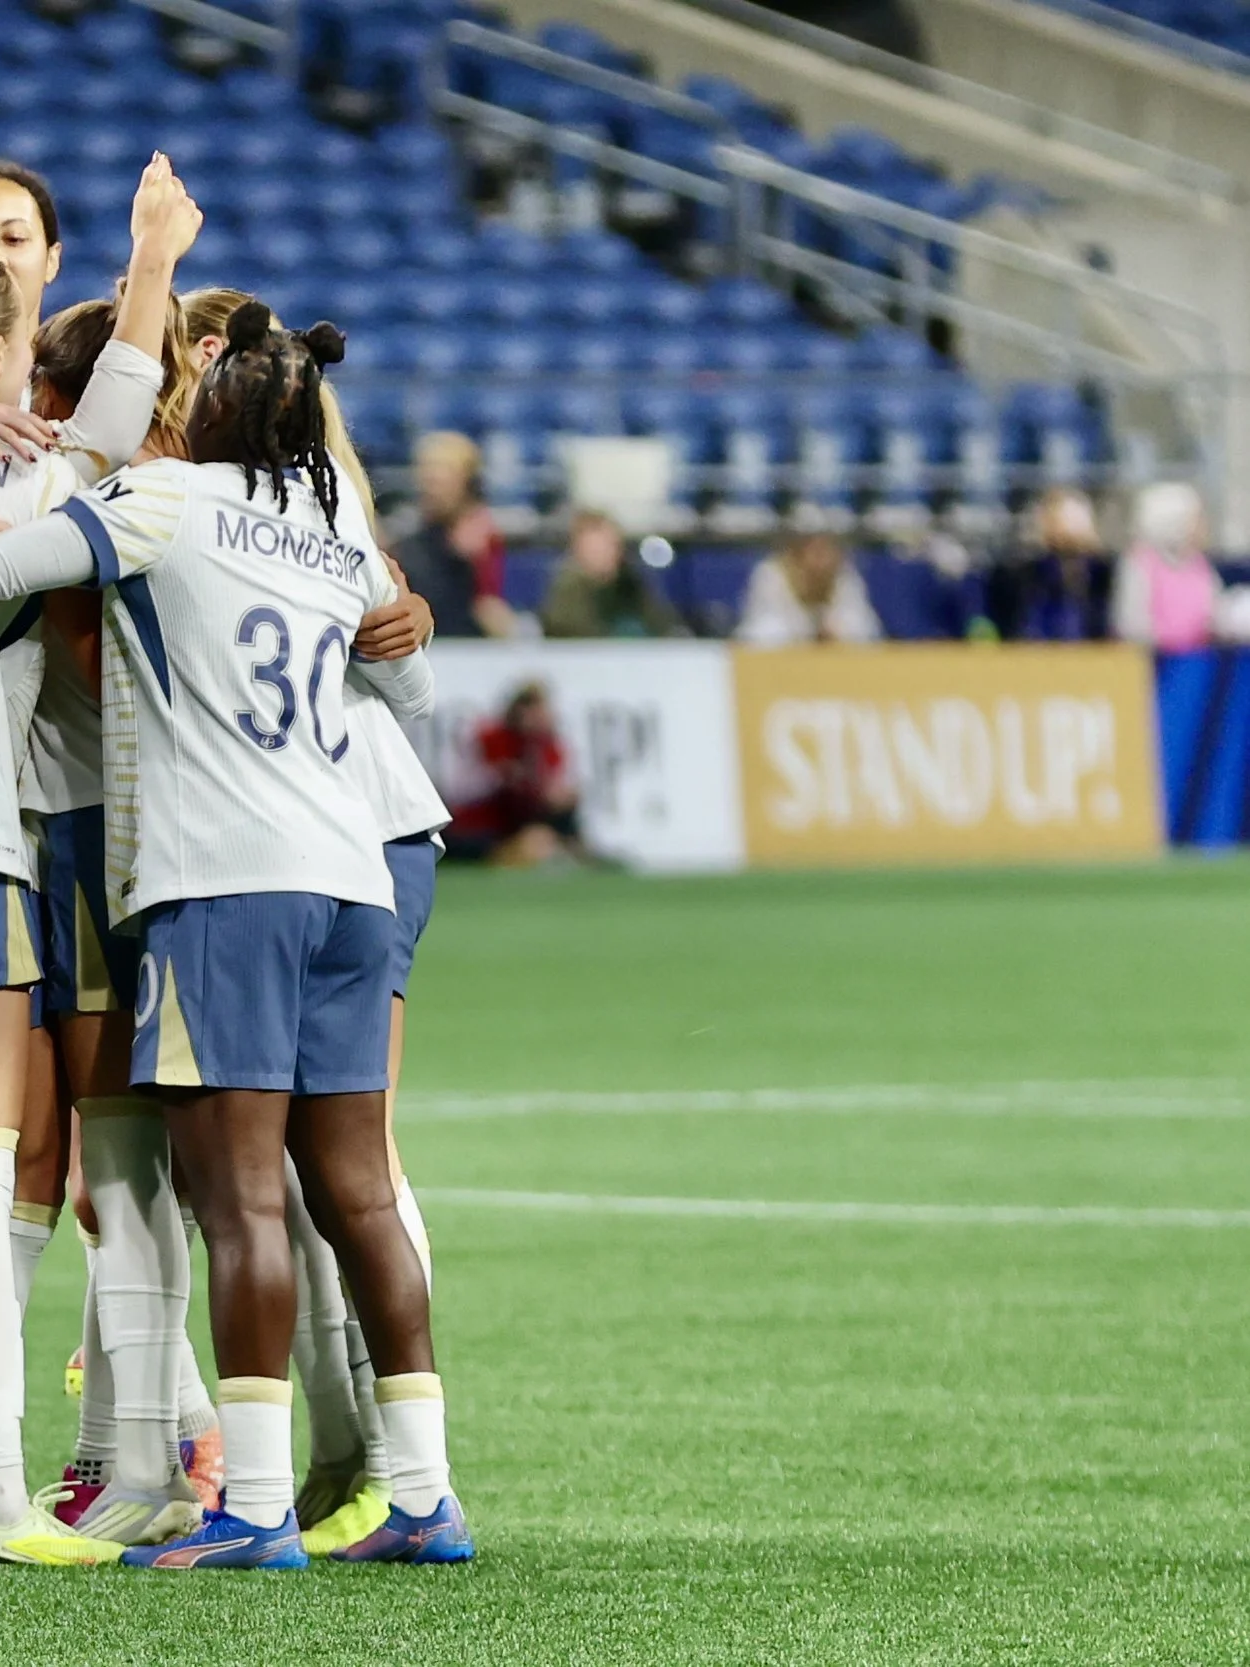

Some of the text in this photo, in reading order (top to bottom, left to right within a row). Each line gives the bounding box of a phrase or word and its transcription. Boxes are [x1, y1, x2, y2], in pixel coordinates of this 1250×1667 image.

[216, 510, 365, 586] MONDESIR
[234, 604, 350, 764] 30
[763, 697, 1122, 832] STAND UP!
